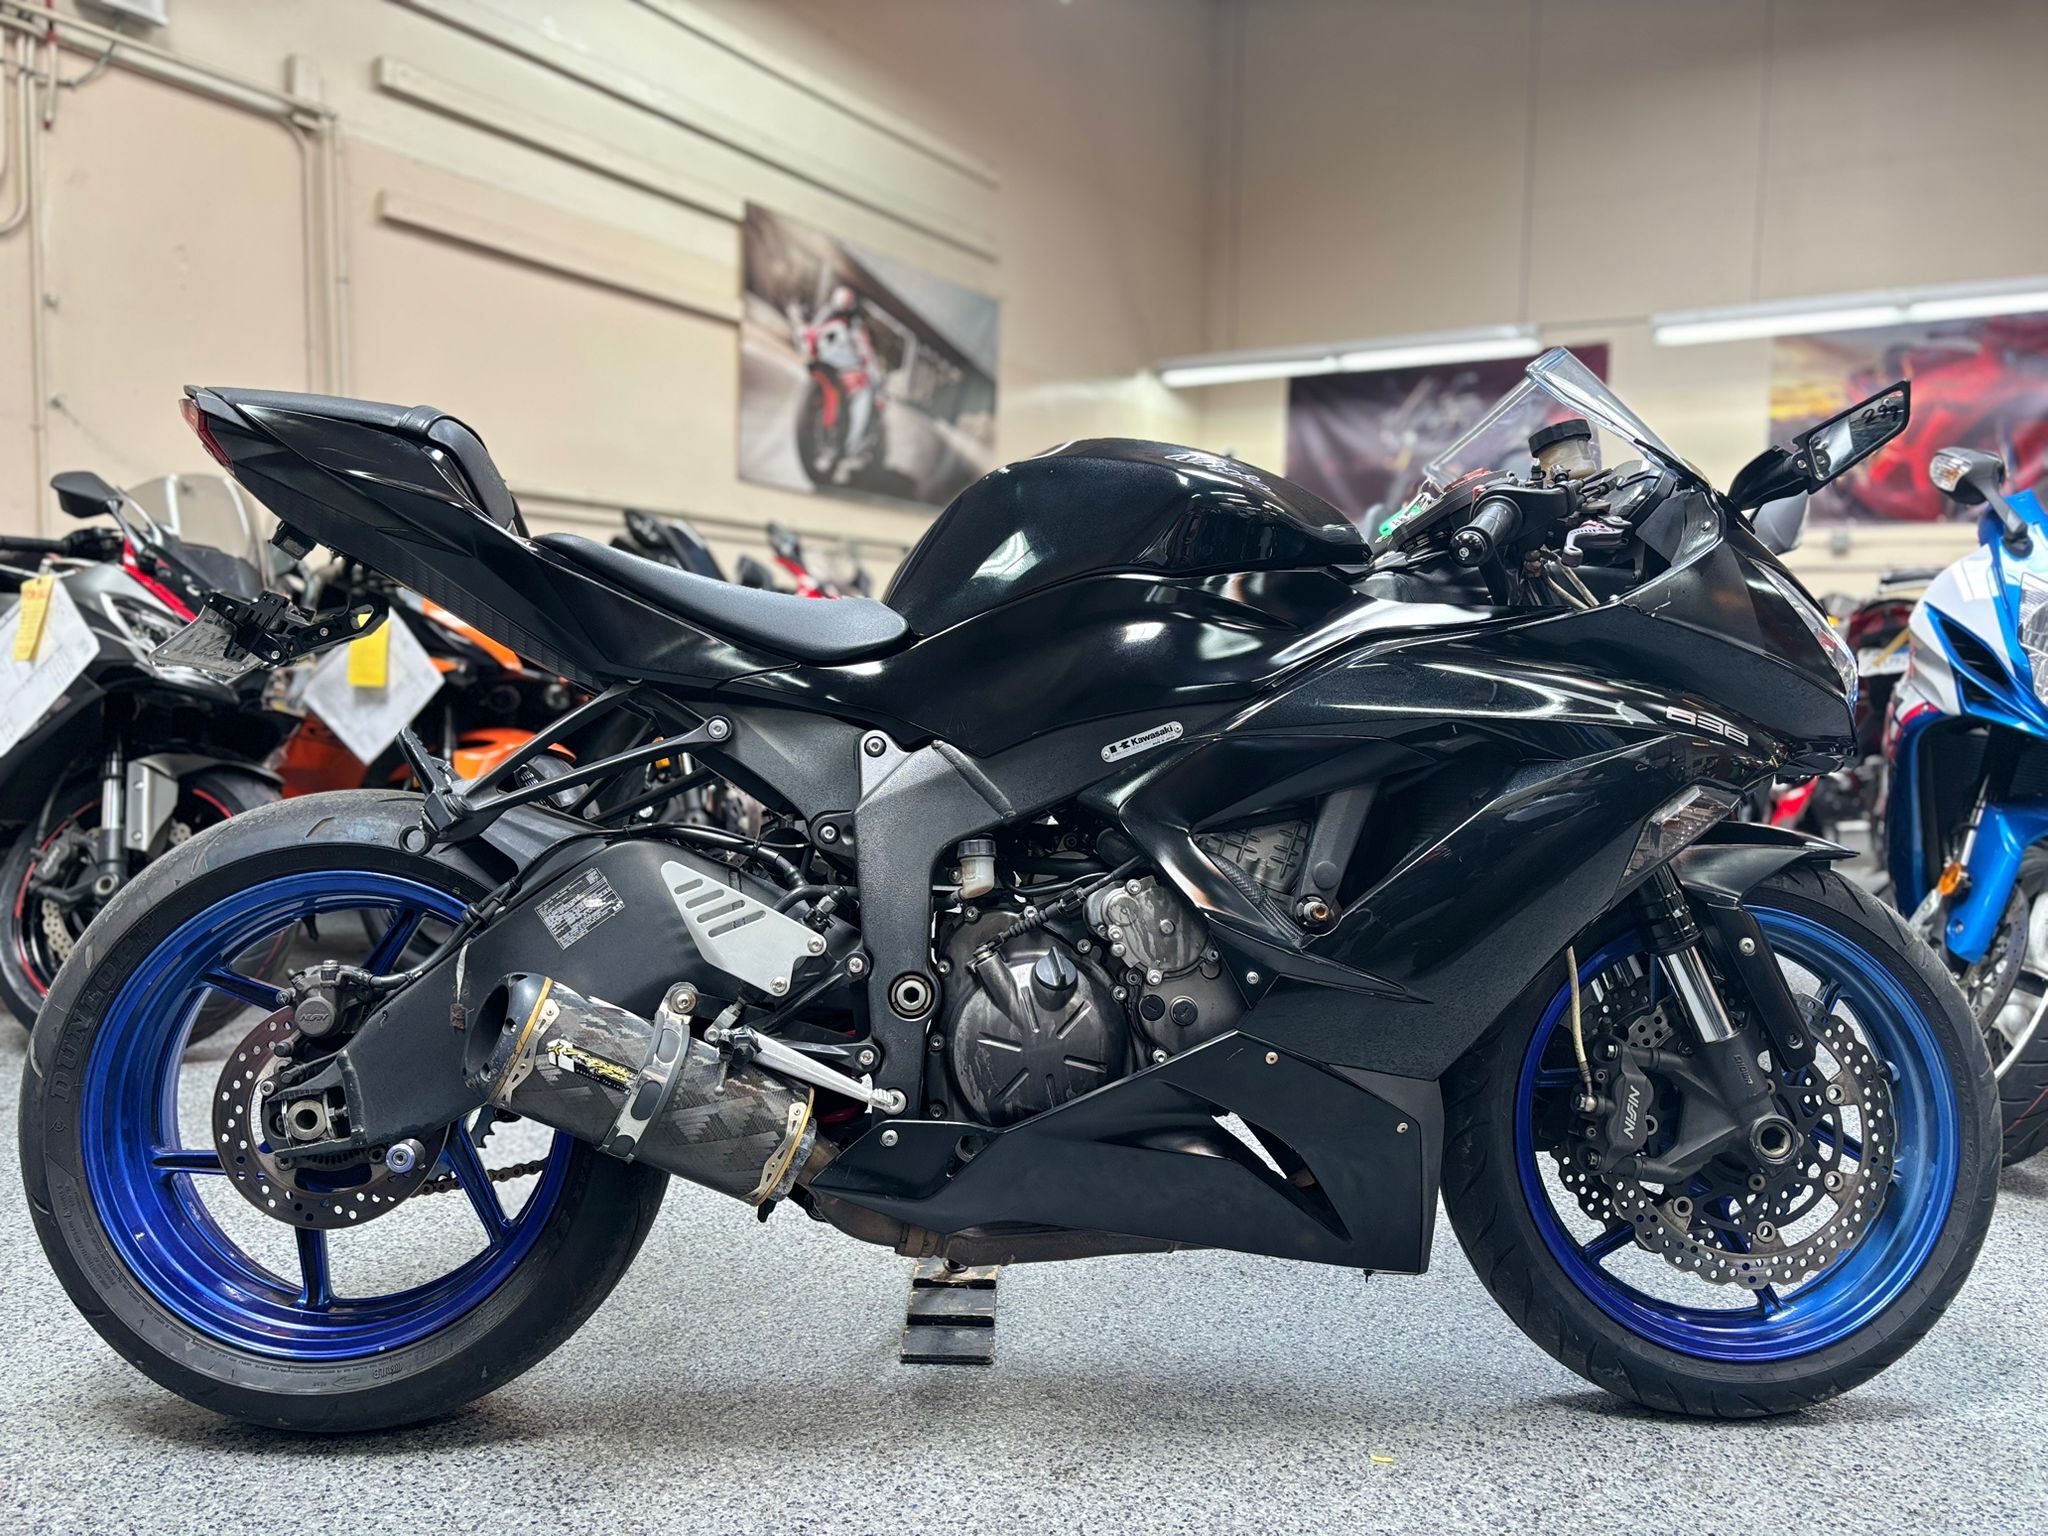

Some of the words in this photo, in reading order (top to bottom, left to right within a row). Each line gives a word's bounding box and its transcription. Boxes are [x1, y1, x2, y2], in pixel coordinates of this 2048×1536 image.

[1130, 725, 1174, 746] Kawasaki
[1666, 705, 1749, 747] 636
[51, 934, 142, 1103] DUNLOP
[1623, 1085, 1641, 1140] NISSIN
